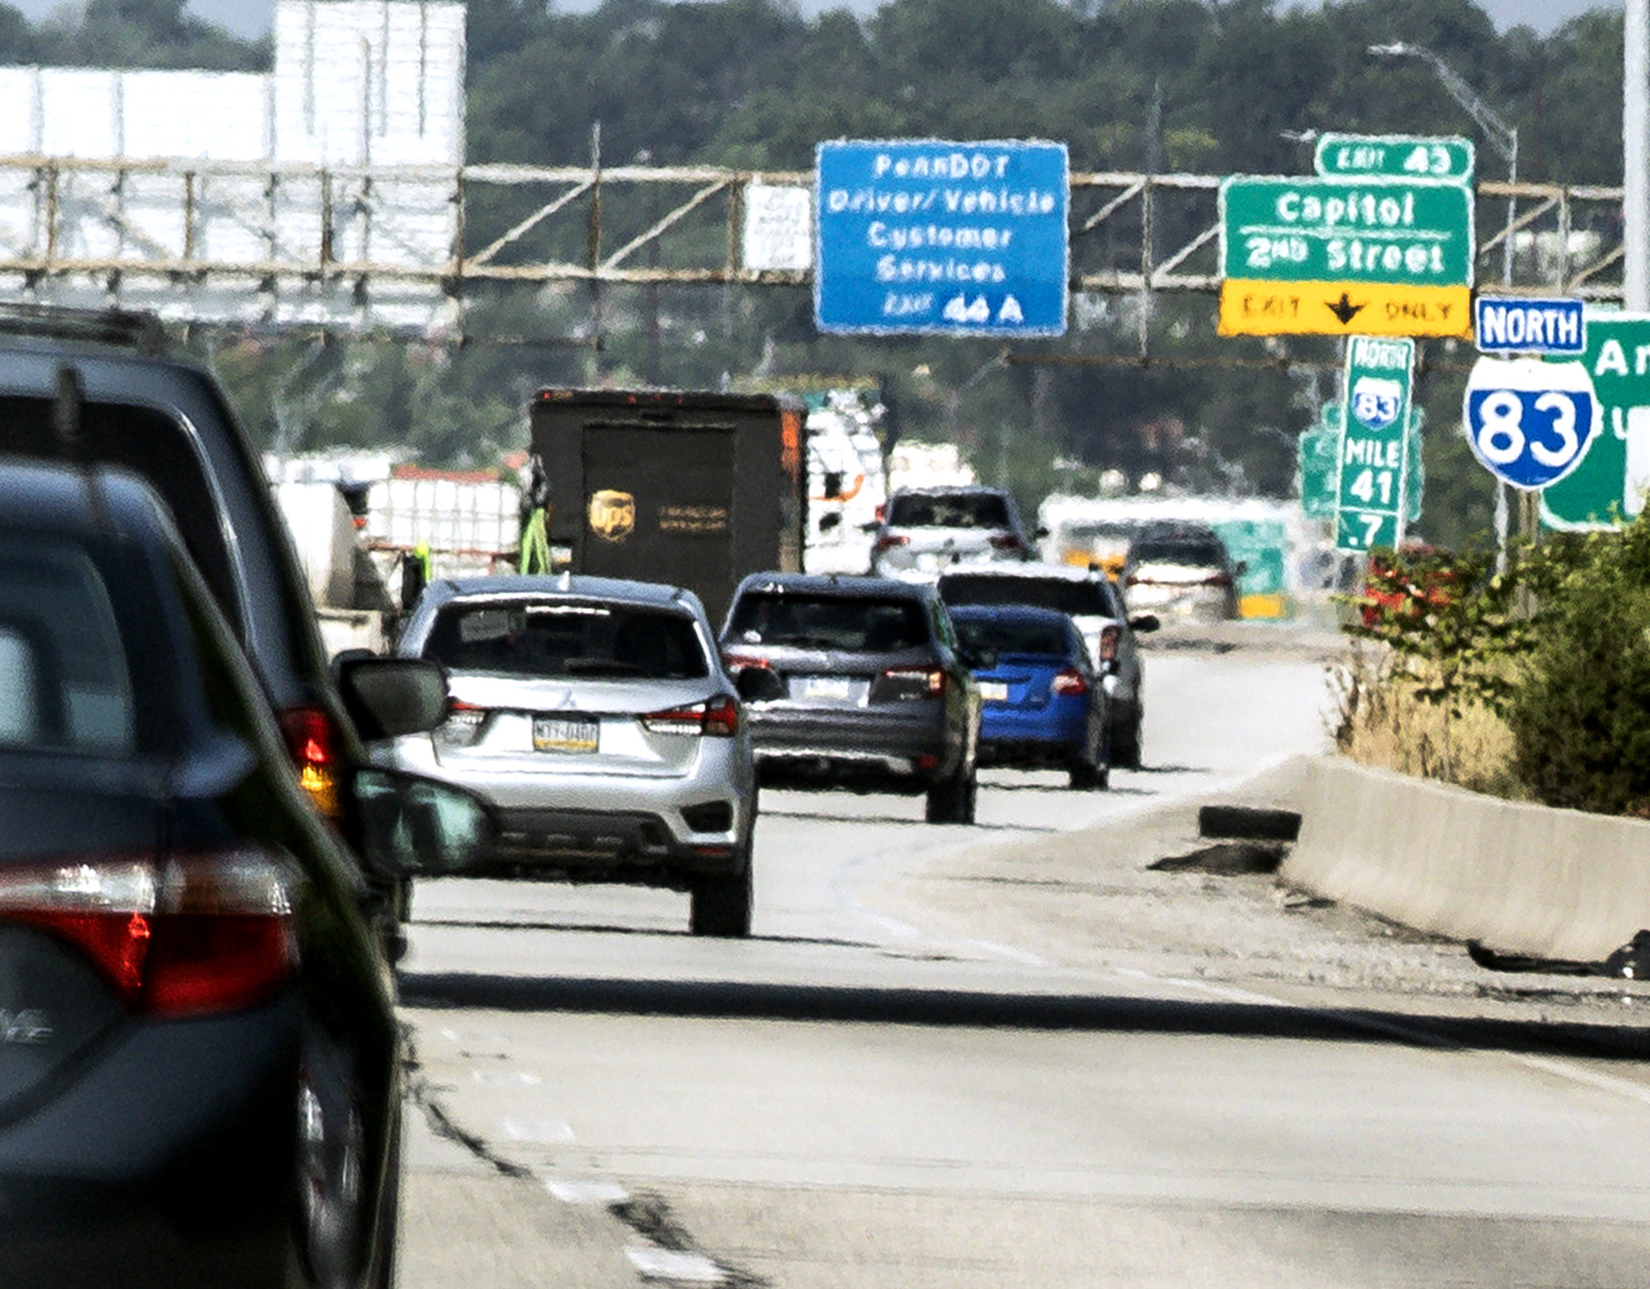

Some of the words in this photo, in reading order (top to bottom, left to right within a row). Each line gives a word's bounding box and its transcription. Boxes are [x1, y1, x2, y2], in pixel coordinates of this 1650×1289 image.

[1403, 147, 1452, 174] 43
[1276, 190, 1414, 226] Capitol
[866, 220, 1012, 250] Customer
[876, 254, 1006, 283] Services
[1326, 238, 1445, 274] Street
[1243, 295, 1301, 318] EXIT
[1385, 299, 1453, 322] ONLY
[1483, 306, 1579, 345] NORTH
[1354, 337, 1407, 369] NORTH
[1357, 393, 1398, 420] 83
[1477, 390, 1581, 468] 83
[1346, 437, 1400, 468] MILE
[1349, 469, 1393, 505] 41
[591, 503, 633, 533] ups
